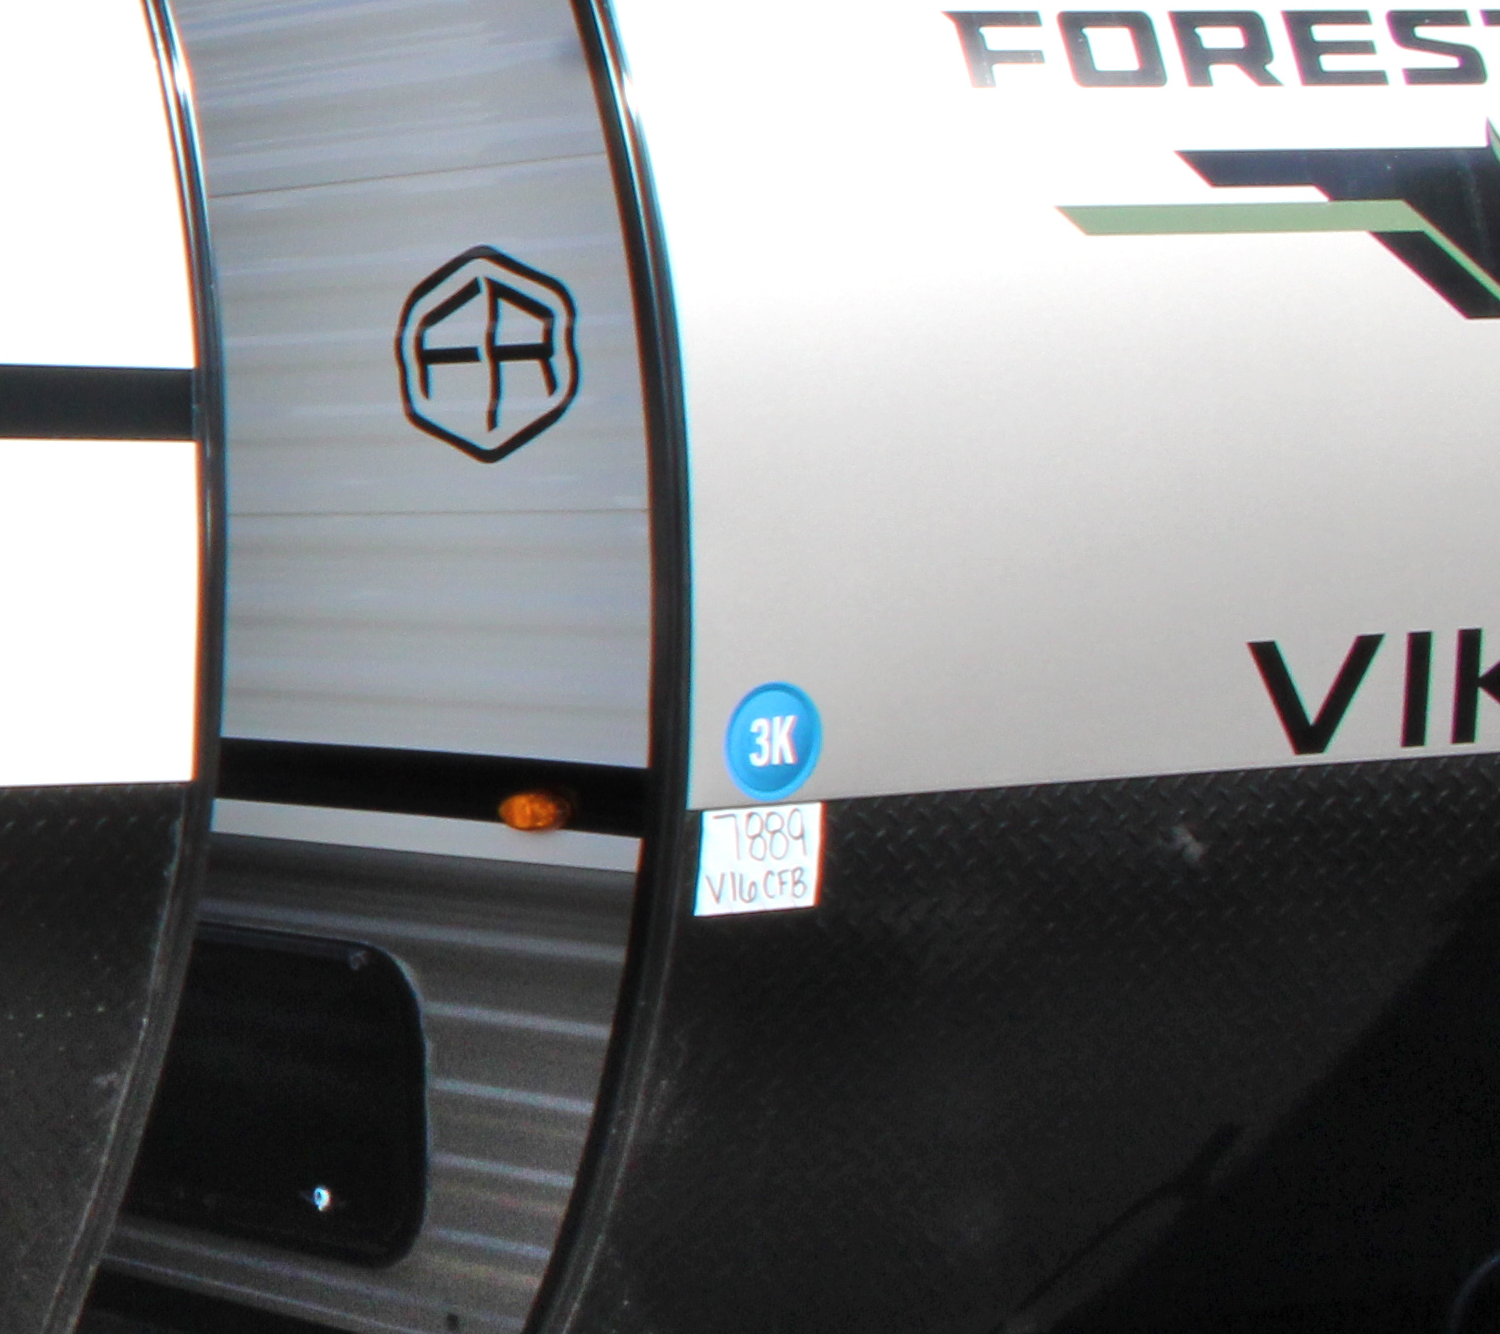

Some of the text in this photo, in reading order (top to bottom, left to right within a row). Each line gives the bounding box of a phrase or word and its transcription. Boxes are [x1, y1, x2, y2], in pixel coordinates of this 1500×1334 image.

[940, 8, 1500, 88] FORES
[747, 715, 799, 767] 3K
[712, 807, 808, 861] 7889
